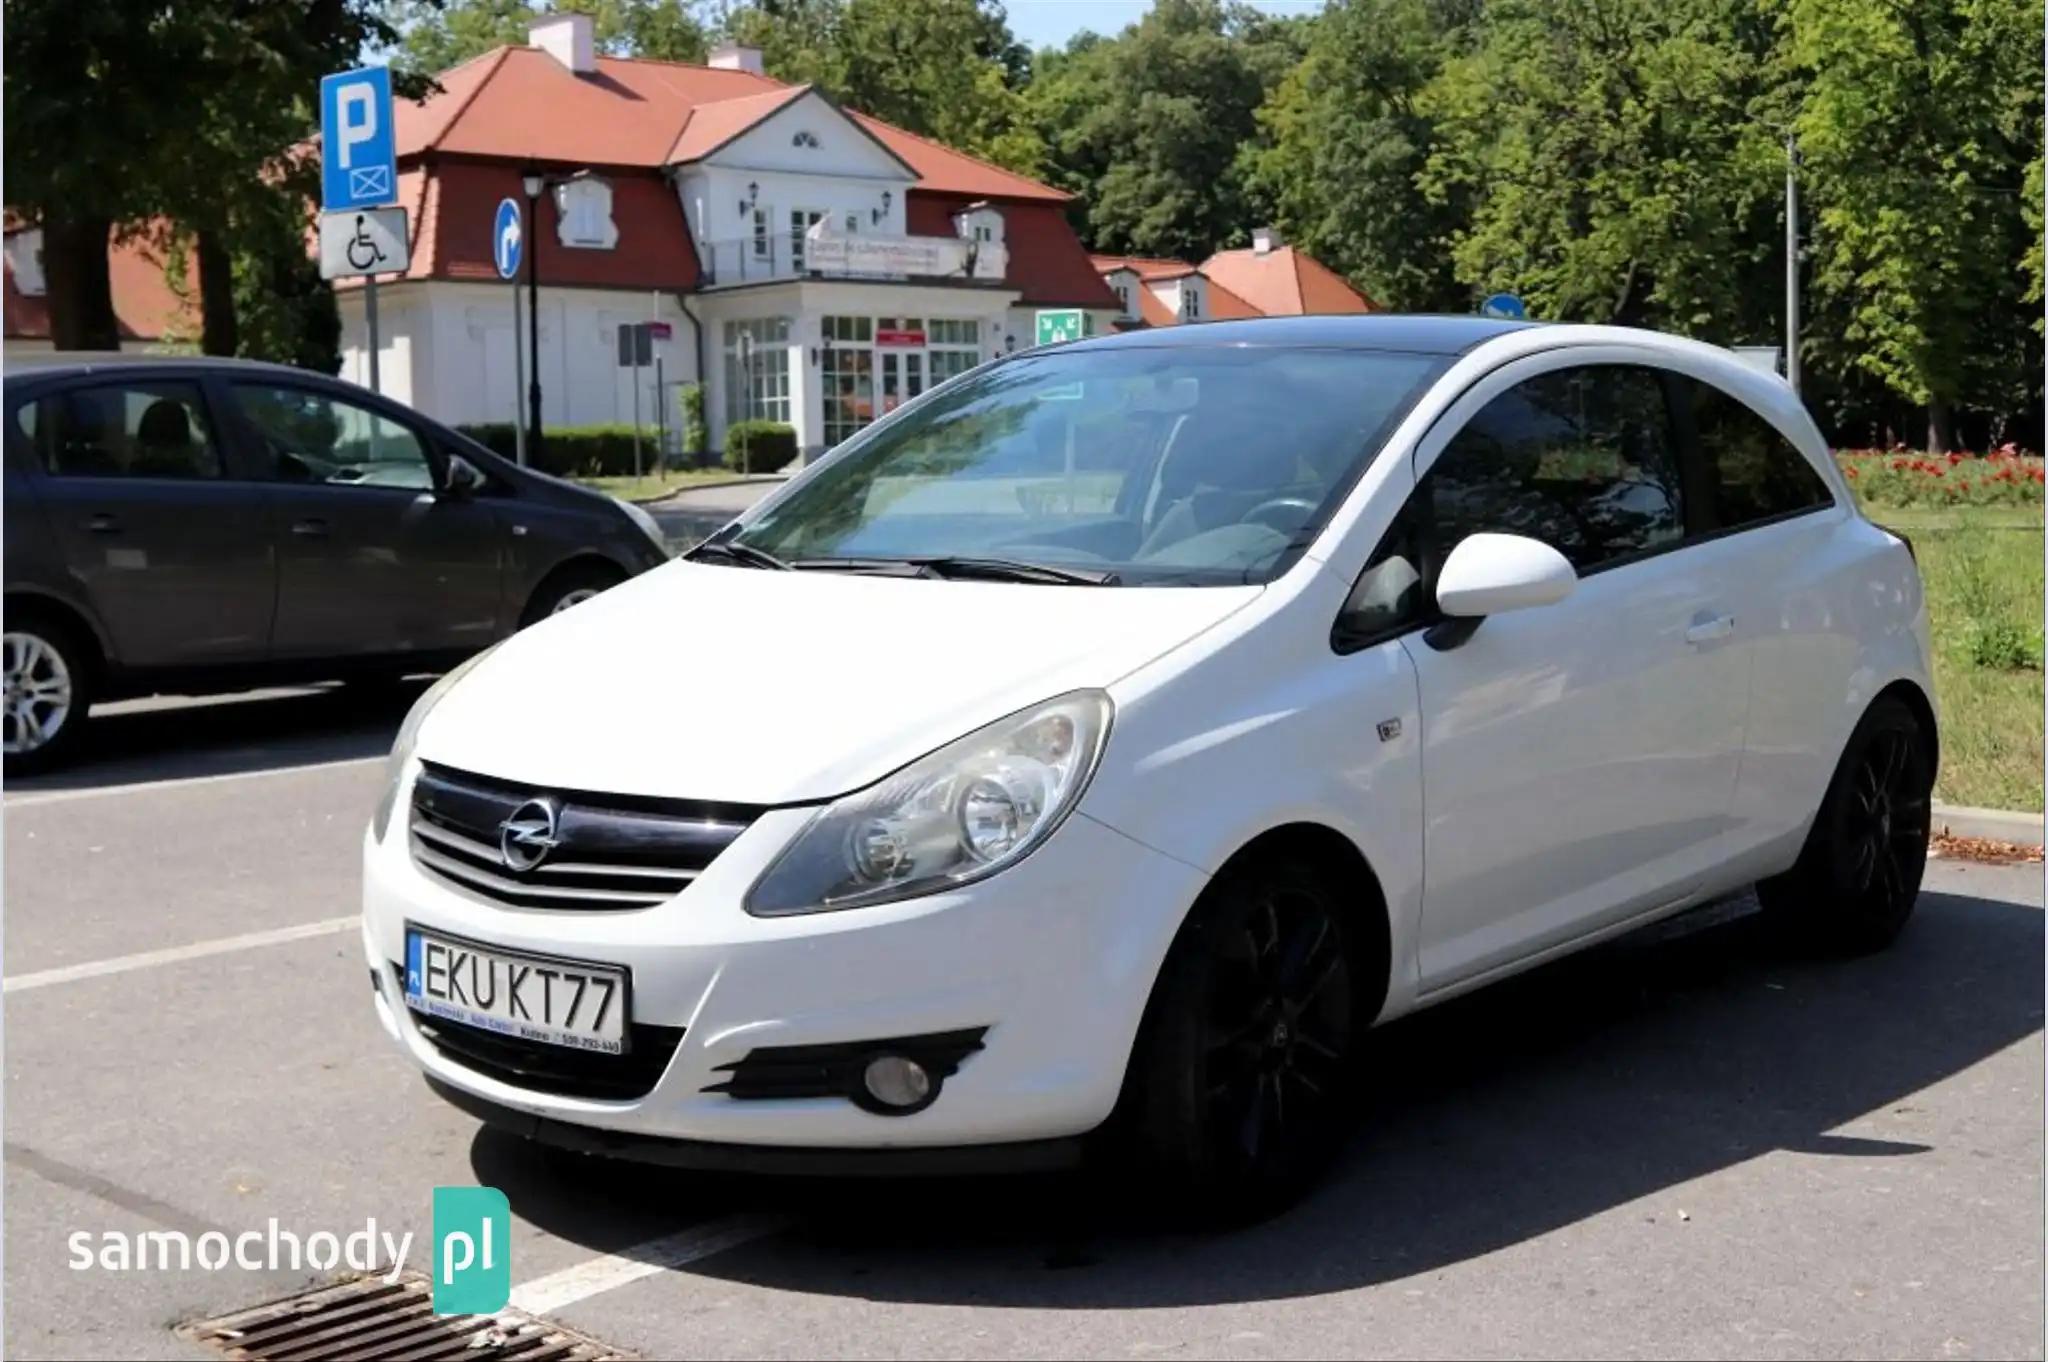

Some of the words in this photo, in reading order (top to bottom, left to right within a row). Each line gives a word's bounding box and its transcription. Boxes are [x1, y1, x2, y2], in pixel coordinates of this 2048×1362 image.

[336, 81, 377, 169] P
[426, 942, 497, 1010] EKU
[508, 963, 617, 1033] KT77
